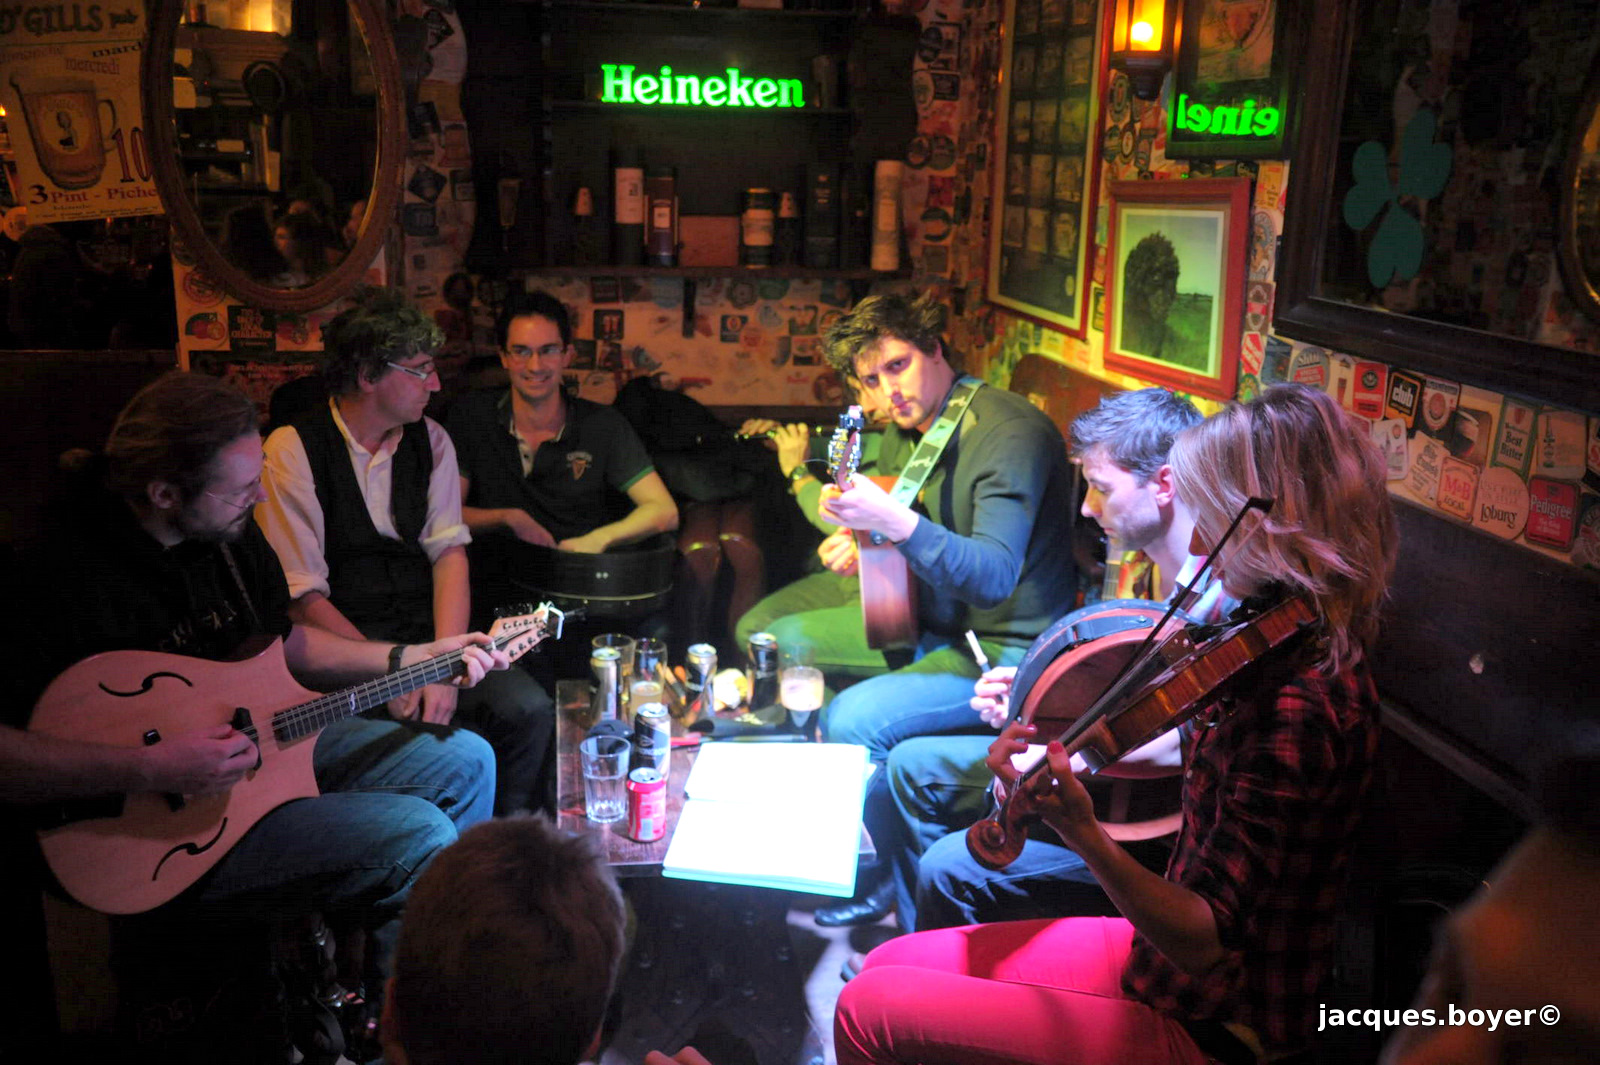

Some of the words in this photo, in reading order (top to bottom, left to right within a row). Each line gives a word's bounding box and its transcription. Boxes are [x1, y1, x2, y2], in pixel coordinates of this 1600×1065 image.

[92, 41, 142, 57] mard
[601, 61, 806, 107] Heineken
[30, 184, 48, 204] 3
[52, 191, 87, 203] Pint
[107, 186, 157, 200] Piche
[1392, 383, 1414, 409] club
[1505, 432, 1523, 447] Best
[1500, 443, 1524, 462] Bitter
[1480, 503, 1518, 529] Loburg
[1530, 493, 1574, 520] Pedigree
